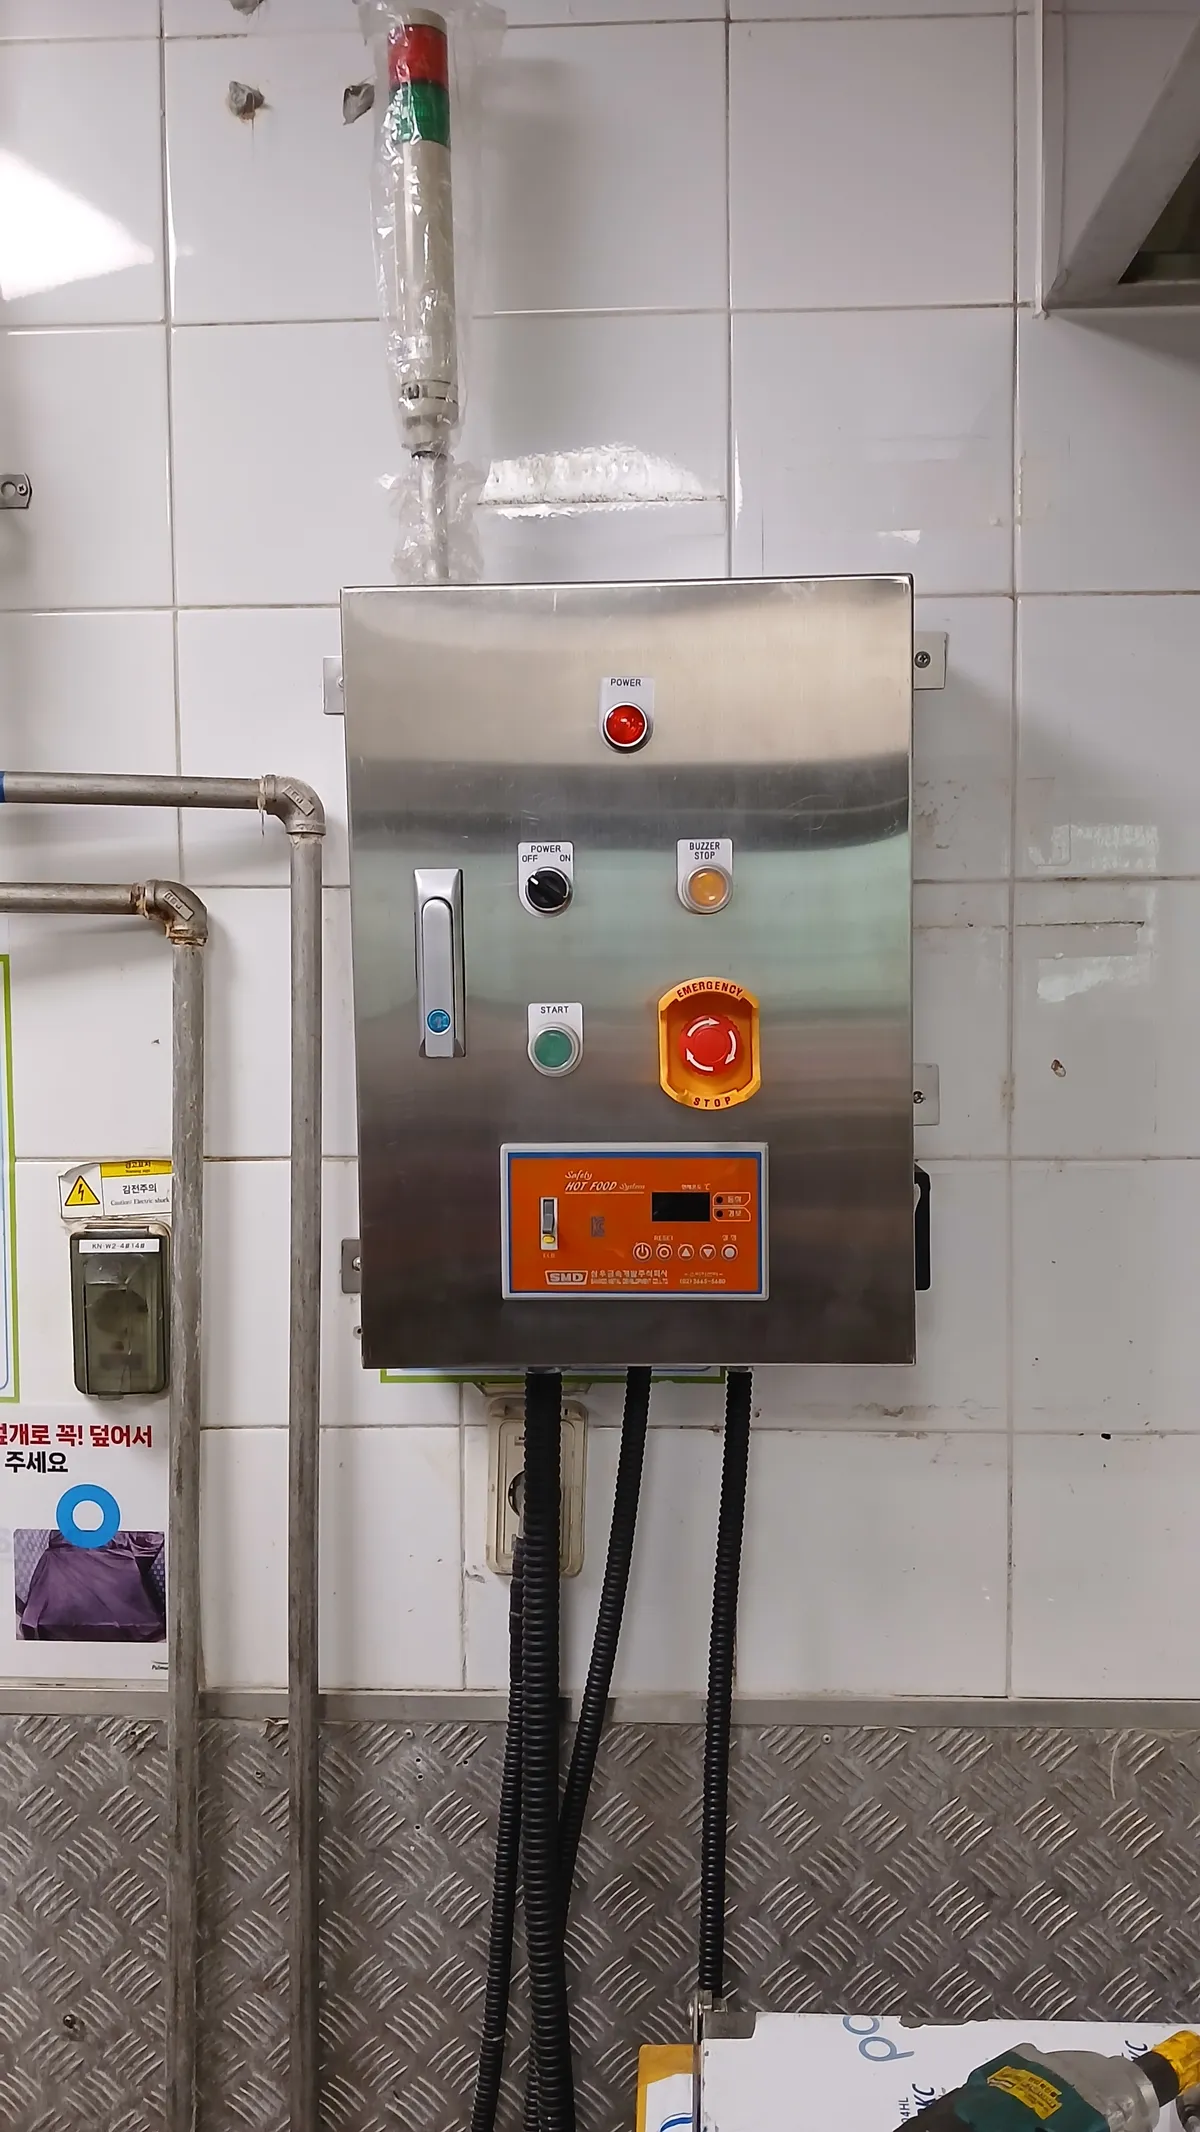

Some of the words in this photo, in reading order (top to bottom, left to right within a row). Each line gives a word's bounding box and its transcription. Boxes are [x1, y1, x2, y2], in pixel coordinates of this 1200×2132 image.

[610, 678, 642, 687] POWER
[530, 844, 562, 853] POWER
[689, 841, 721, 851] BUZZER
[521, 854, 538, 863] OFF
[559, 854, 571, 862] ON
[694, 851, 716, 860] STOP
[676, 981, 743, 998] EMERGENCY
[540, 1005, 569, 1014] START
[693, 1096, 731, 1107] STOP
[564, 1169, 593, 1180] Safety
[565, 1181, 588, 1191] HOT
[589, 1181, 617, 1191] FOOD
[549, 1272, 583, 1282] SMD
[55, 1424, 83, 1447] 꼭!
[89, 1425, 152, 1448] 덮어서
[5, 1451, 68, 1473] 주세요
